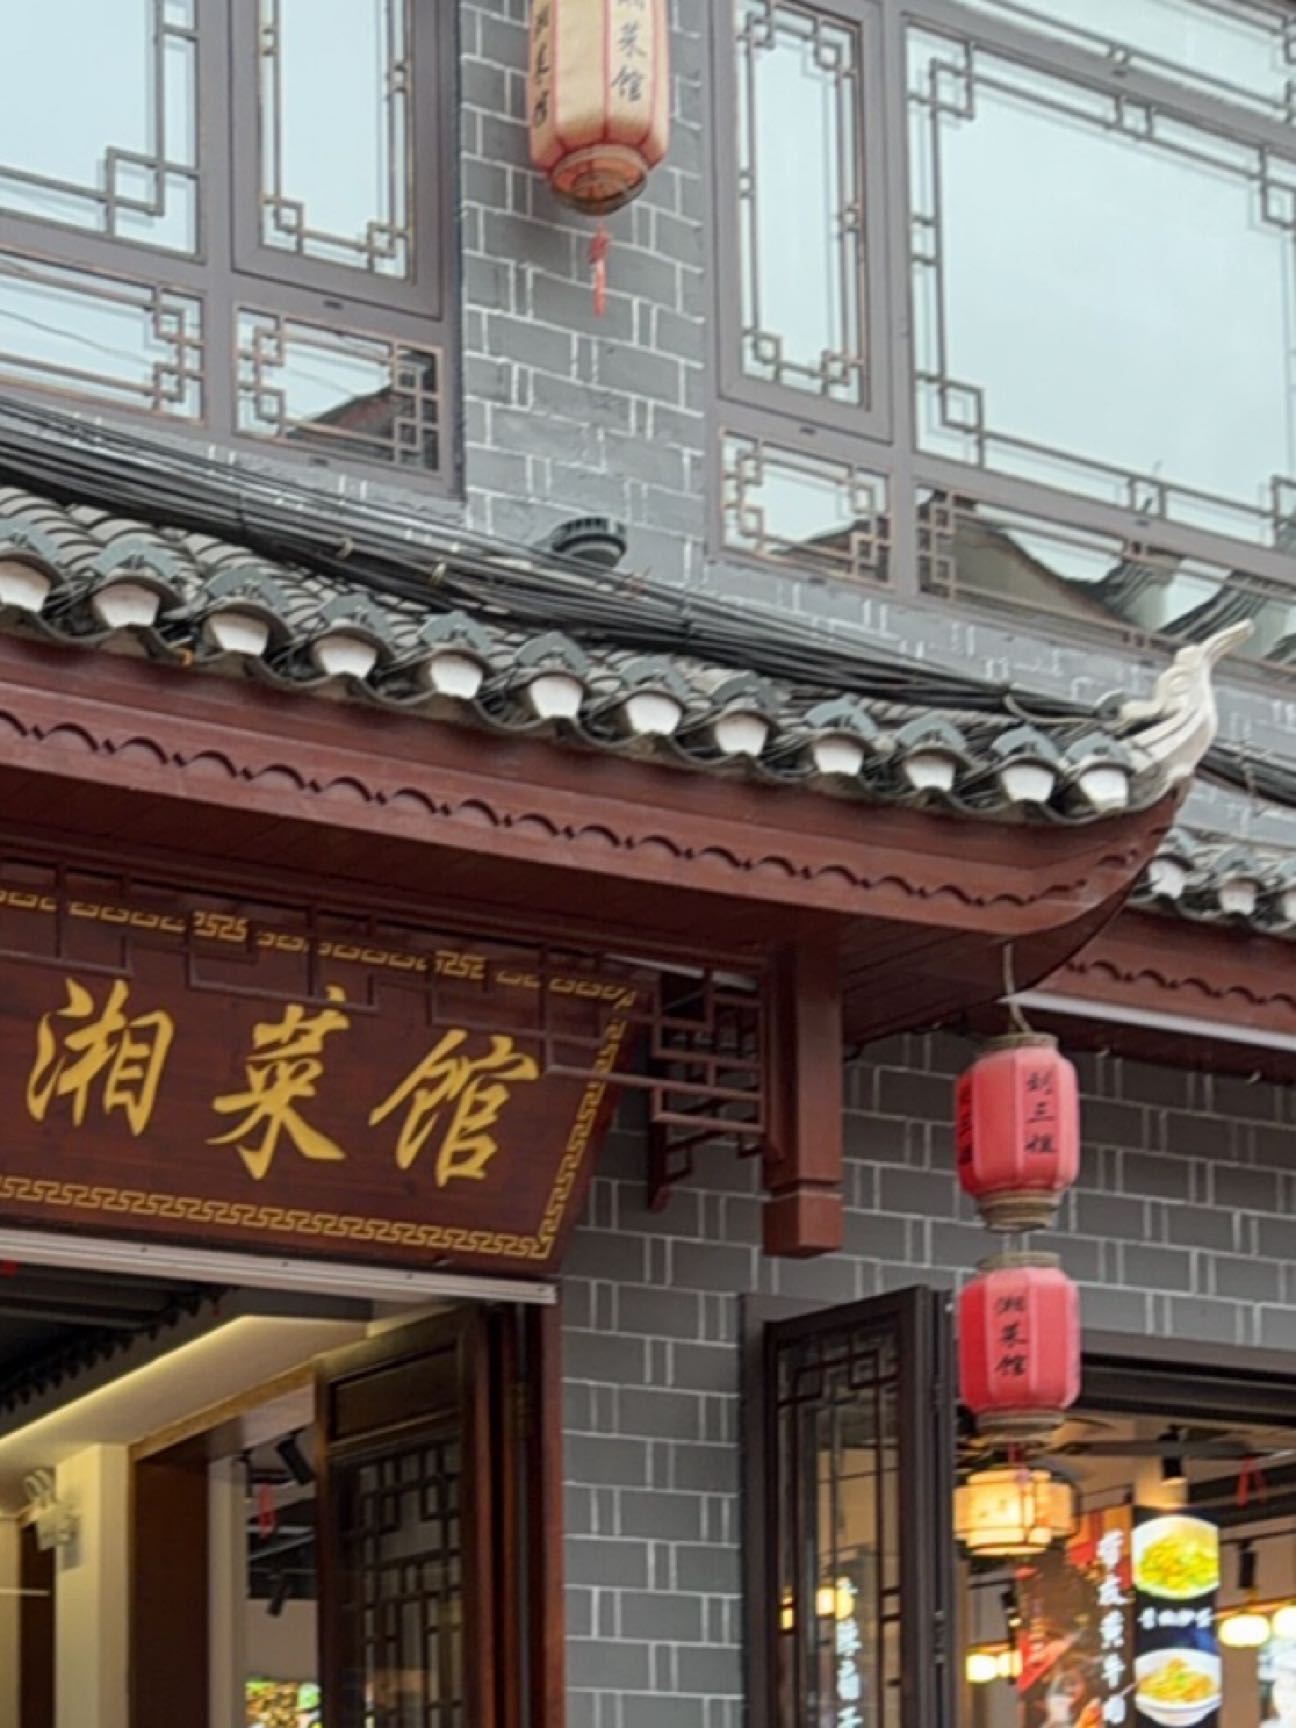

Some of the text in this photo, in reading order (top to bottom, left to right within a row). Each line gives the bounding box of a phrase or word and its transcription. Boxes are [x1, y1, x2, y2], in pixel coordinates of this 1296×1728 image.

[610, 0, 648, 102] 菜馆
[1024, 1066, 1059, 1153] 刘三姐
[993, 1296, 1029, 1376] 湘菜馆
